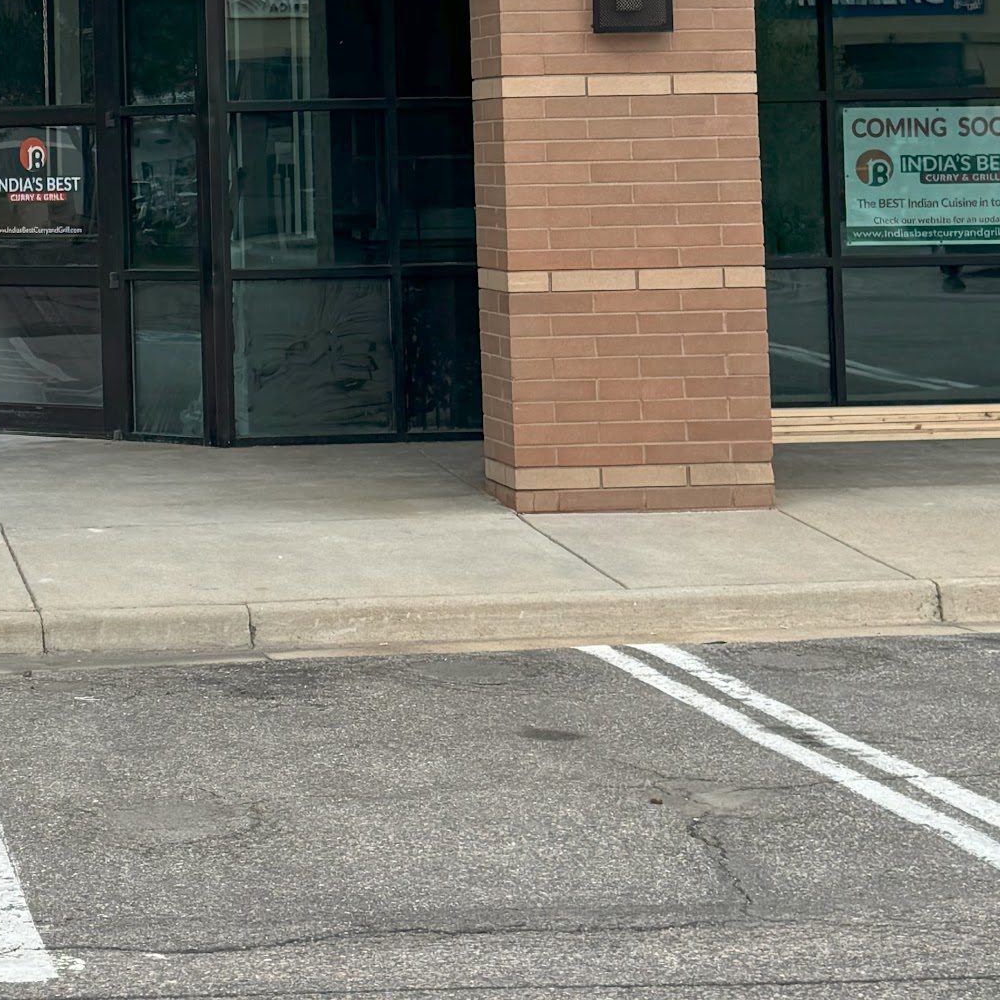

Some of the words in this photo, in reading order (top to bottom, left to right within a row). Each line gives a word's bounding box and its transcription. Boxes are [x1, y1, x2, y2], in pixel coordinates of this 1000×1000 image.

[851, 117, 947, 138] COMING
[901, 155, 971, 172] INDIA'S
[46, 176, 81, 191] BEST
[925, 173, 960, 182] CURRY
[961, 173, 969, 181] &
[972, 173, 1000, 181] GRILL
[10, 194, 35, 202] CURRY
[43, 193, 65, 201] GRILL
[856, 198, 876, 209] The
[878, 198, 906, 209] BEST
[908, 198, 938, 208] Indian
[941, 197, 977, 208] Cuisine
[980, 196, 989, 207] in
[873, 216, 899, 225] Check
[917, 216, 951, 224] website
[953, 215, 964, 224] for
